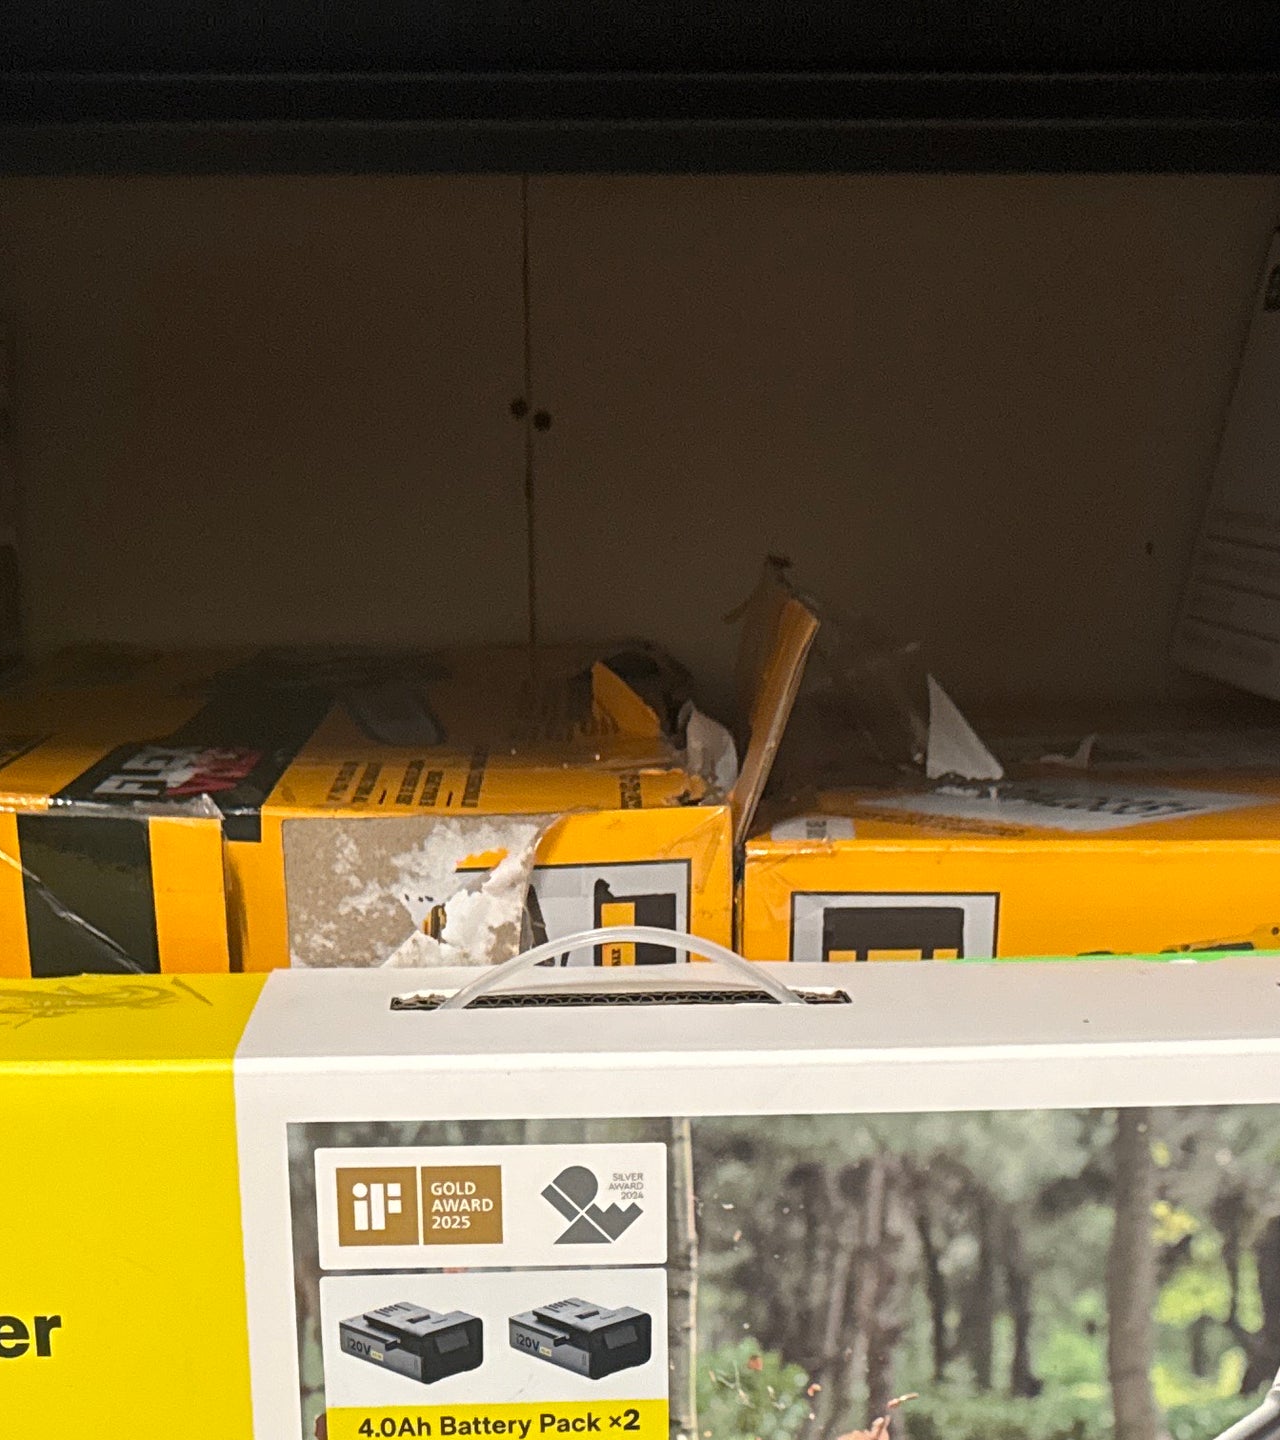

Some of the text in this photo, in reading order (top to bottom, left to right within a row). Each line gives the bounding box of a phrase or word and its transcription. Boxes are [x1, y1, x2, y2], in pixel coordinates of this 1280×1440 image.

[611, 1171, 645, 1183] SILVER
[430, 1180, 477, 1197] GOLD
[607, 1181, 645, 1192] AWARD
[430, 1197, 494, 1213] AWARD
[431, 1214, 472, 1230] 2025
[357, 1412, 602, 1440] 4.0Ah Battery Pack
